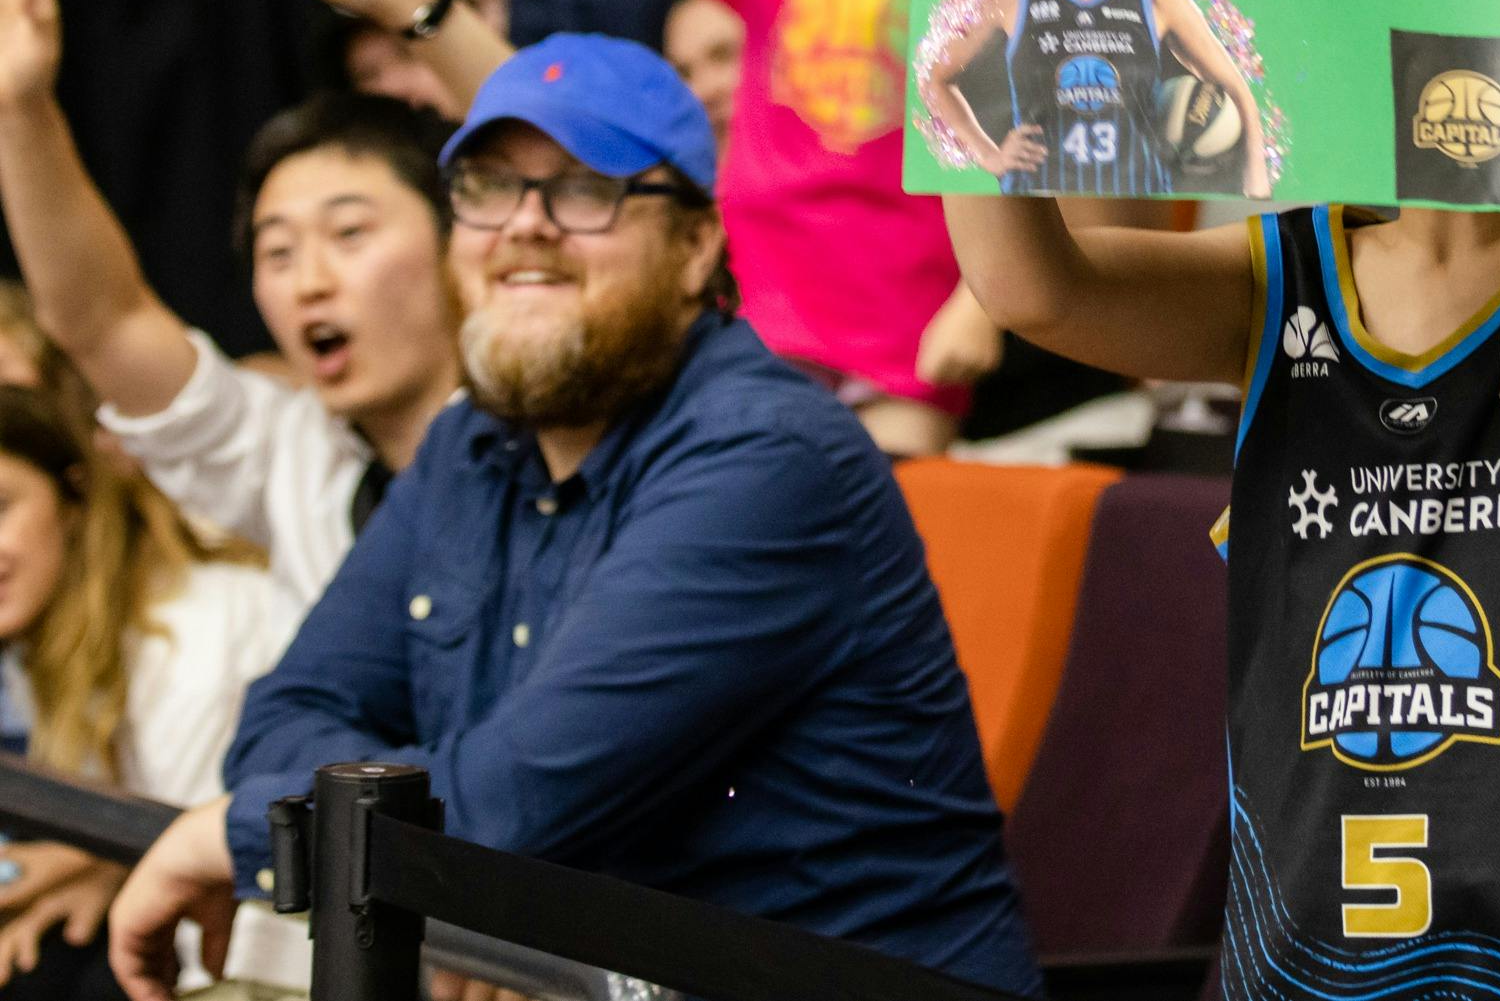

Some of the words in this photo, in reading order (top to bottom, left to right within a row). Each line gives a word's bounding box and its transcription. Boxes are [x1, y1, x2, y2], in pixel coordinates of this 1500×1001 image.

[1063, 121, 1117, 163] 43
[1309, 683, 1494, 735] CAPITALS
[1341, 815, 1432, 938] 5
